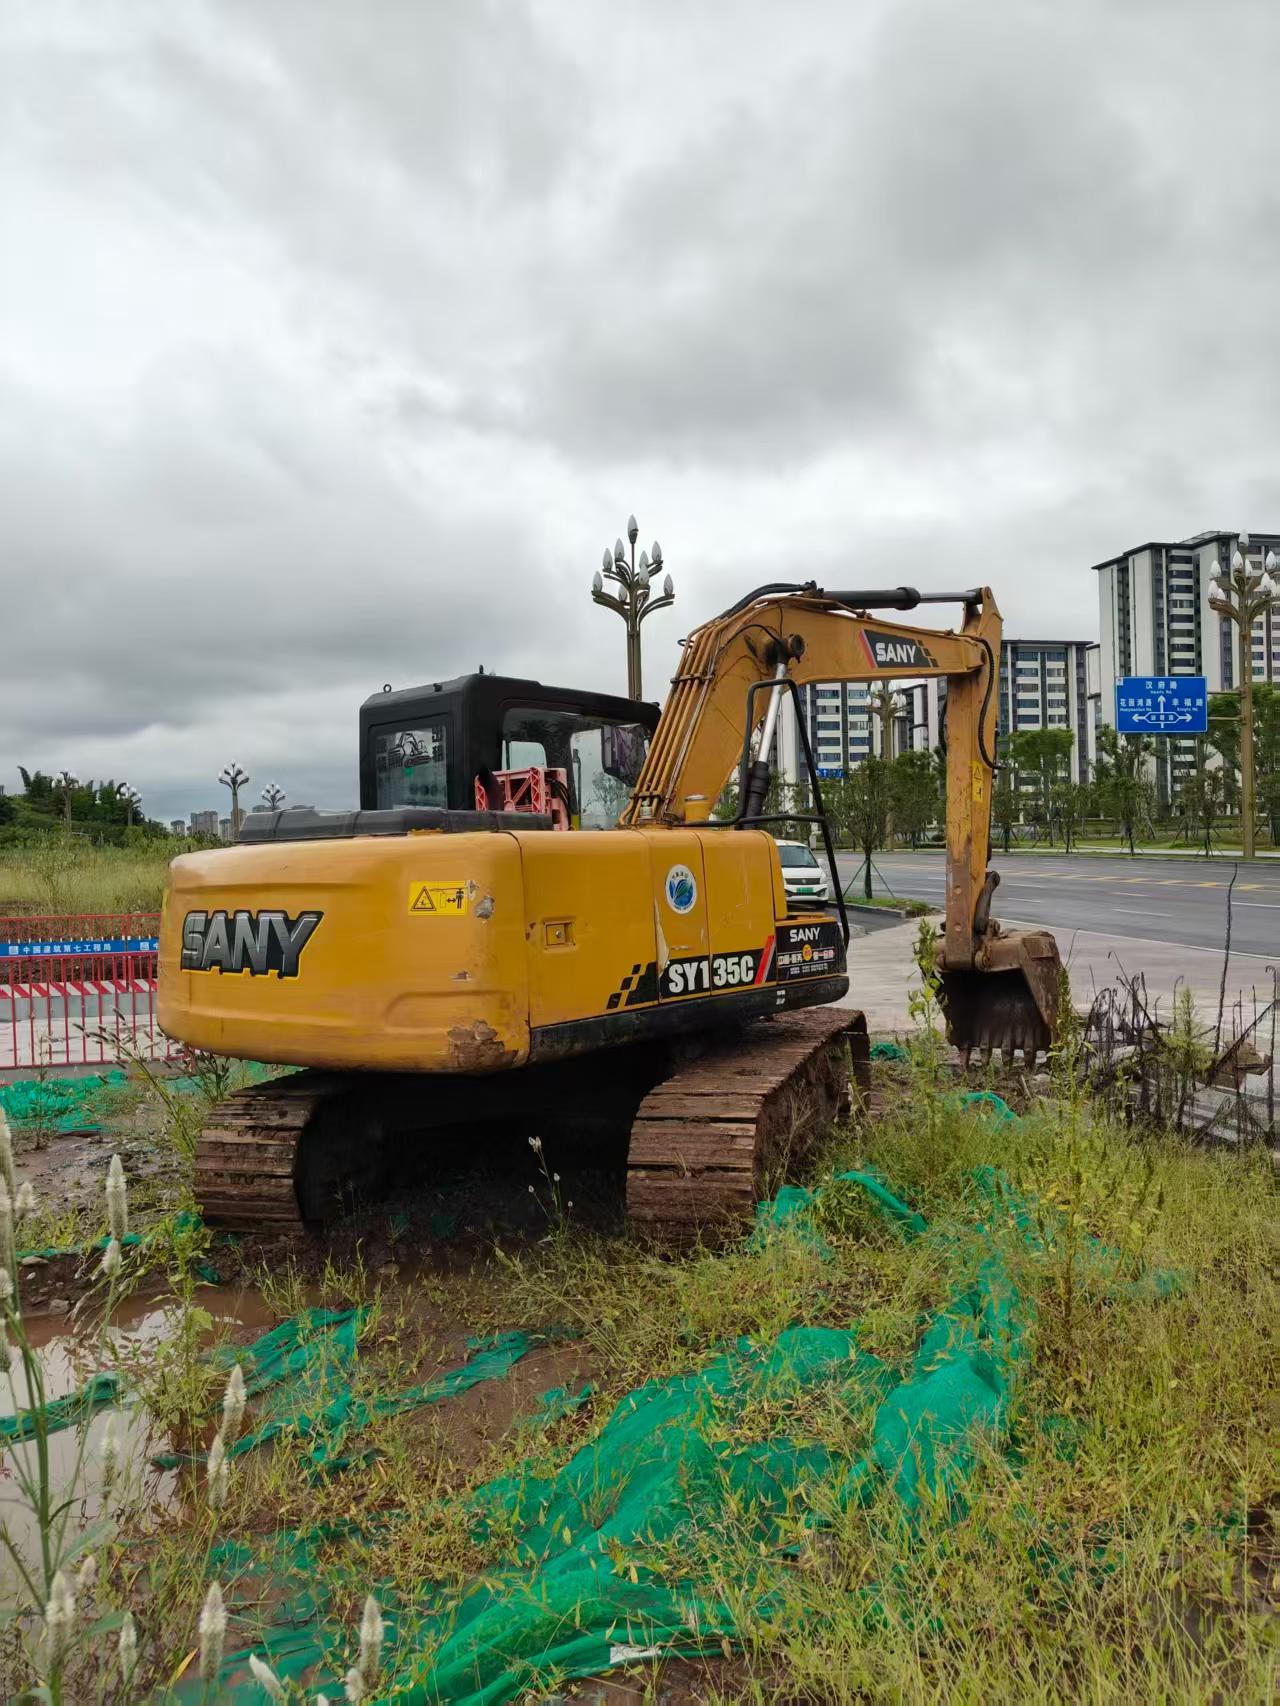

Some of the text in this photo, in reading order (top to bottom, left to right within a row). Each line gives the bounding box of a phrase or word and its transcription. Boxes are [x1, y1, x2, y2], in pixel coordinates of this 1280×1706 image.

[876, 642, 916, 664] SANY
[181, 909, 325, 979] SANY
[789, 927, 820, 943] SANY
[668, 955, 754, 994] SY135C
